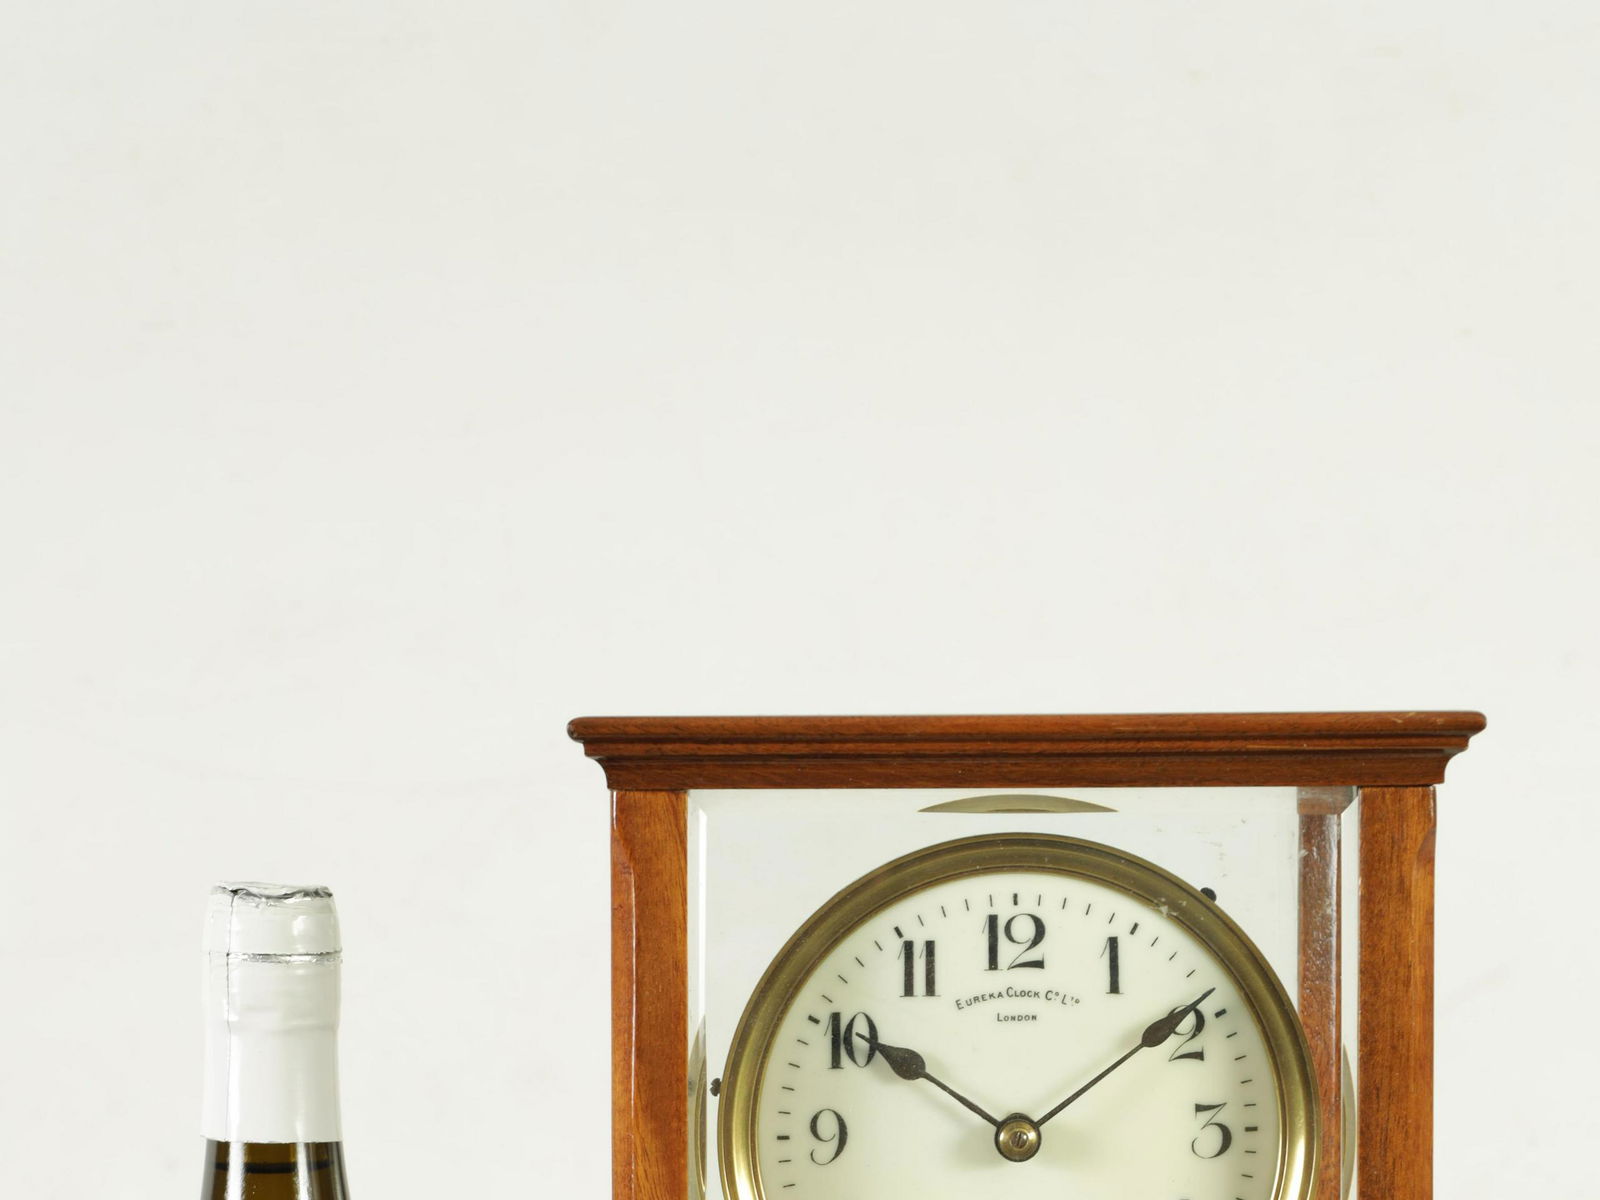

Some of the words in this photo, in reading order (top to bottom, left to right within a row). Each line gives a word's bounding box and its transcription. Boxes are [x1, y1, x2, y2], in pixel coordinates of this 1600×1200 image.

[898, 940, 941, 997] 11
[982, 913, 1045, 971] 12
[1100, 936, 1124, 994] 1
[823, 1011, 879, 1069] 10
[1166, 1004, 1206, 1062] 2
[809, 1108, 848, 1165] 9
[1191, 1102, 1232, 1159] 3
